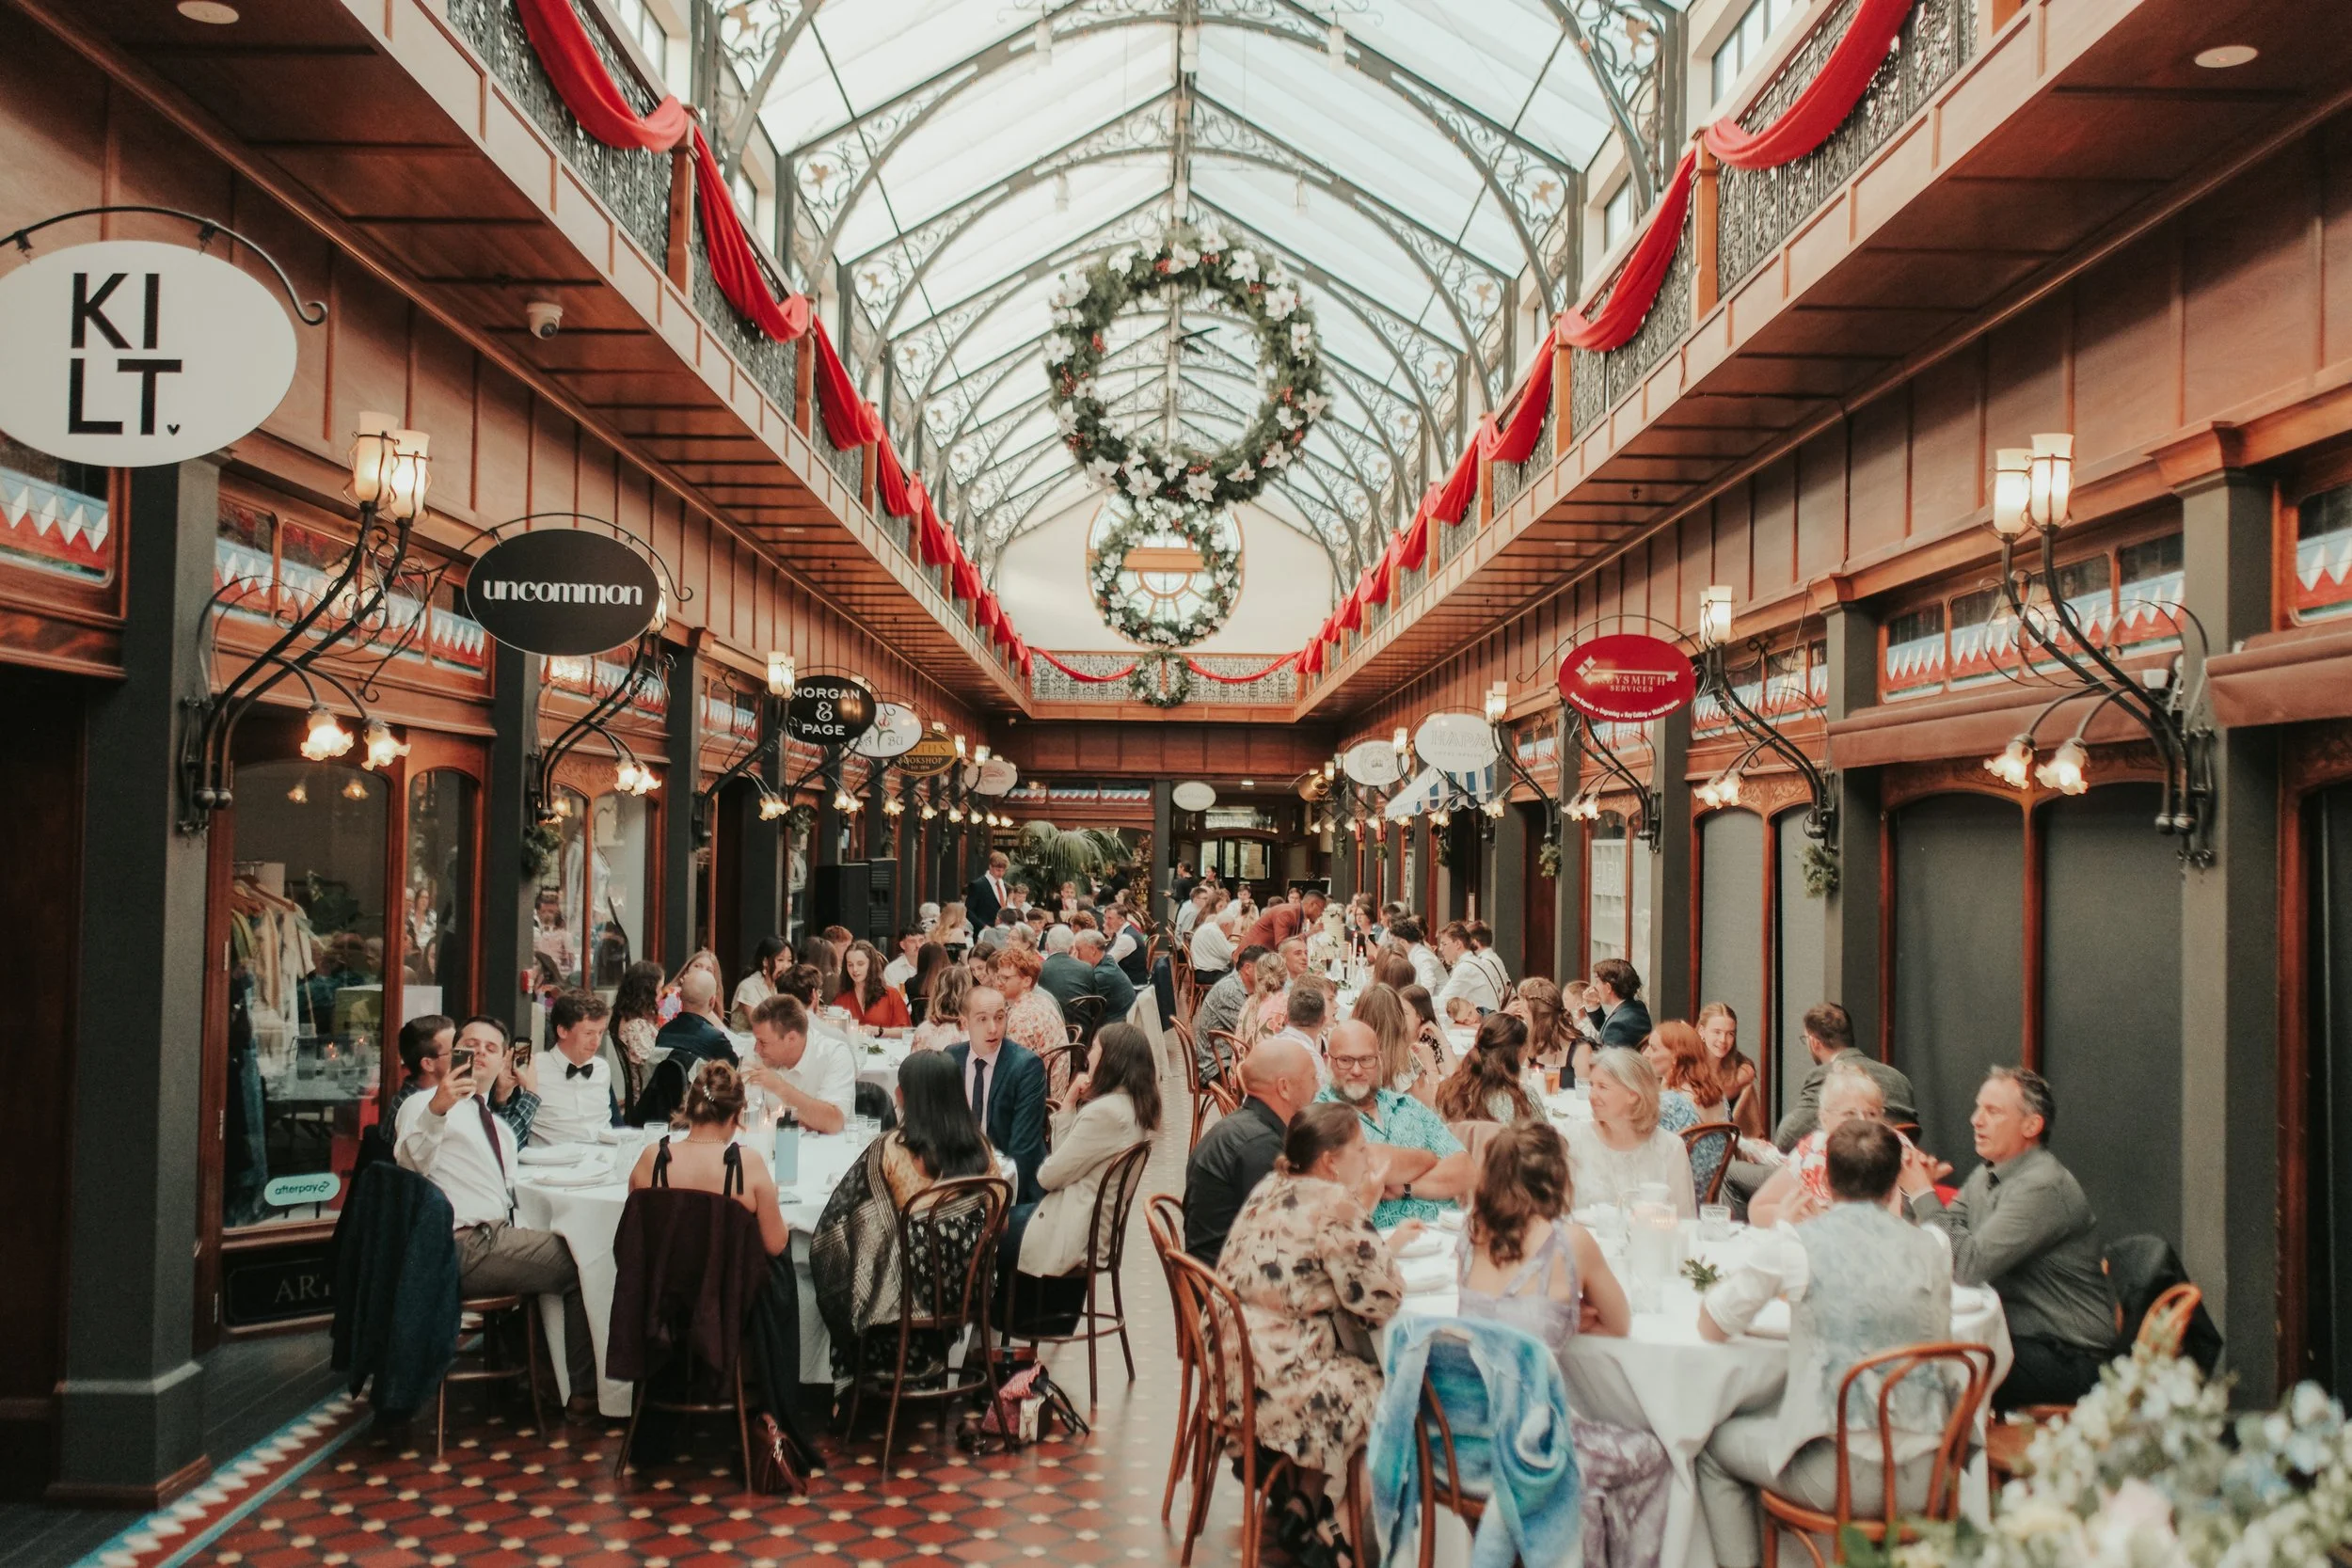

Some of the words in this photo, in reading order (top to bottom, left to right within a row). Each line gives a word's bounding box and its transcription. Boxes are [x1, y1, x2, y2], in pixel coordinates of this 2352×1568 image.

[484, 580, 643, 606] uncommon
[794, 687, 860, 700] MORGAN
[1610, 685, 1653, 693] SERVICES
[816, 701, 834, 721] &
[802, 723, 845, 736] PAGE
[275, 1184, 318, 1195] afterpay
